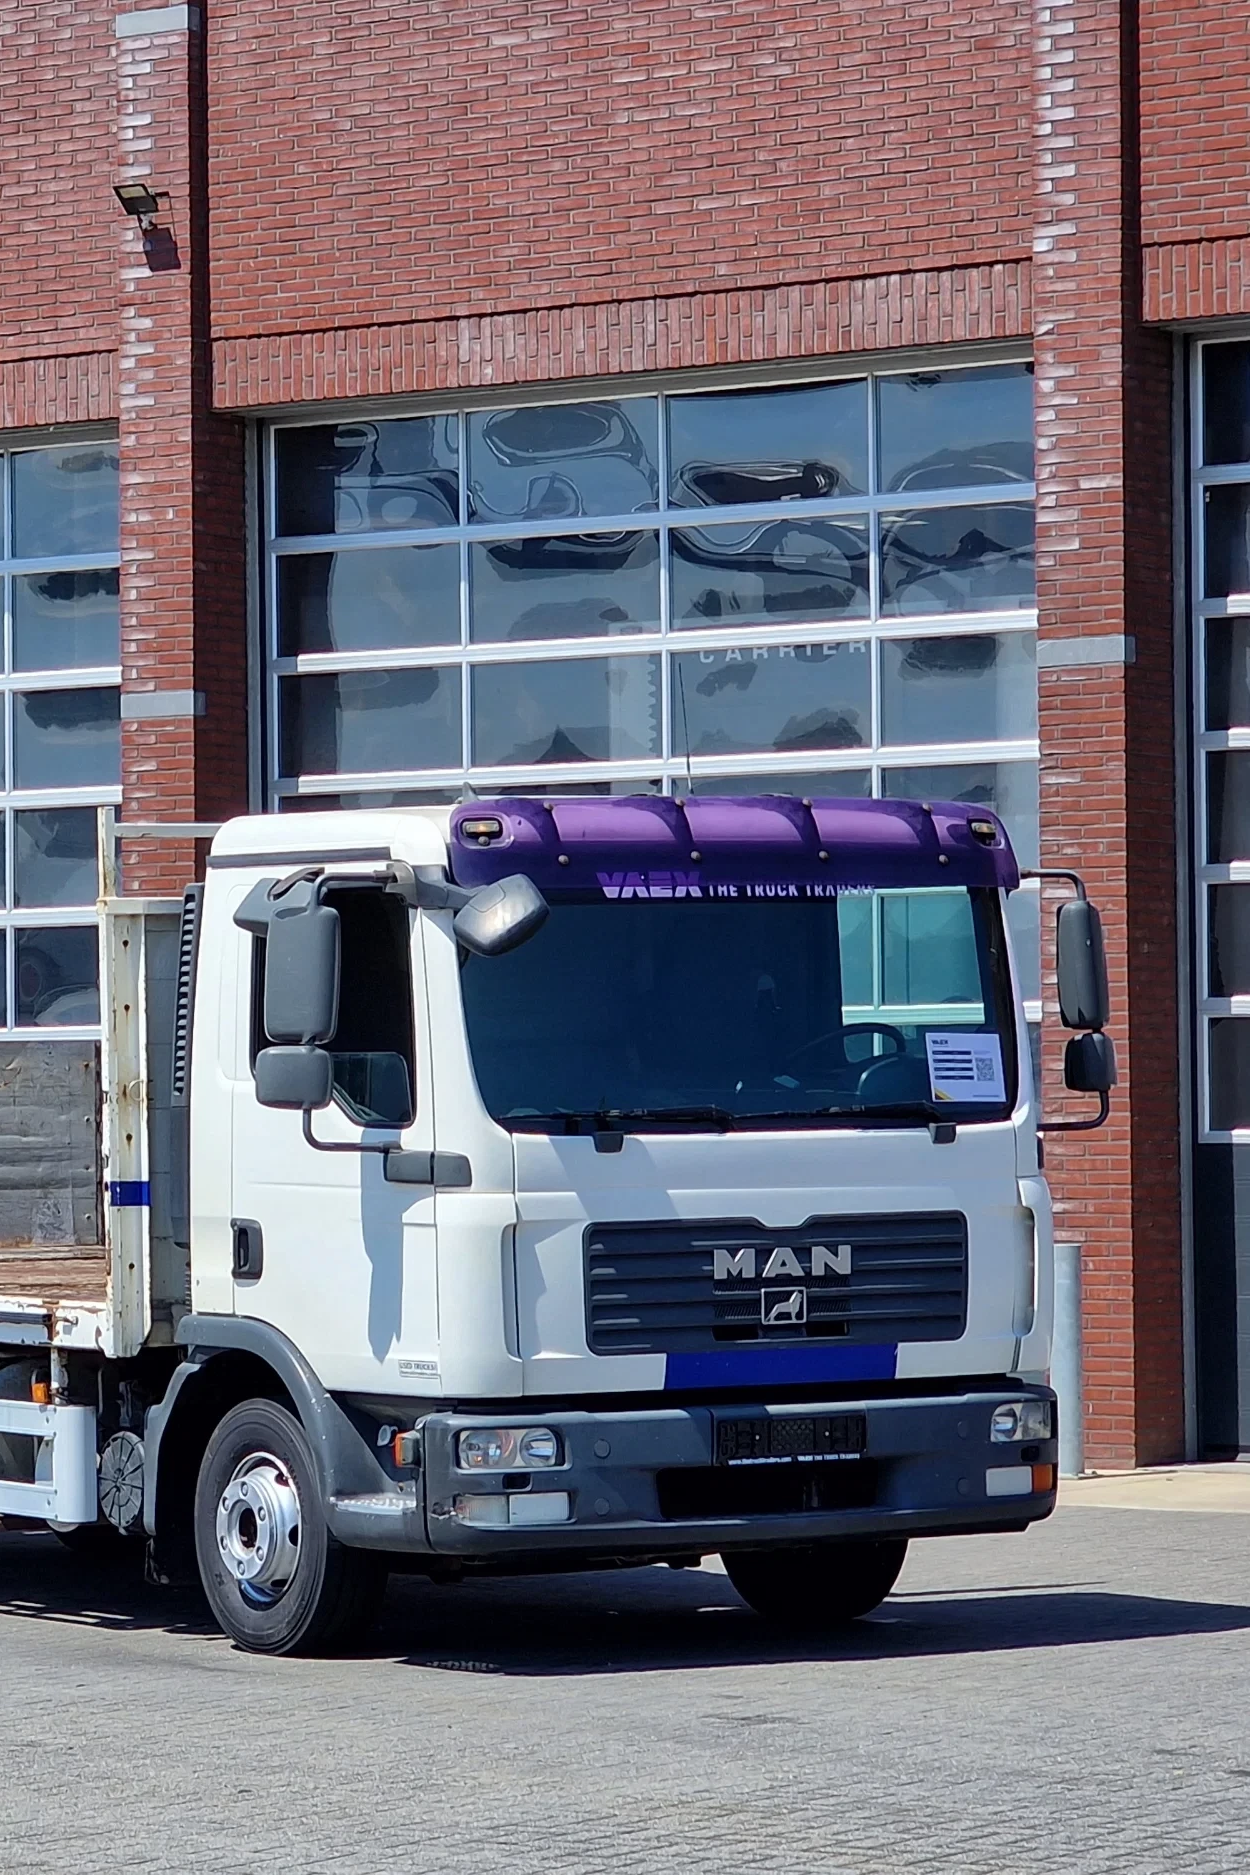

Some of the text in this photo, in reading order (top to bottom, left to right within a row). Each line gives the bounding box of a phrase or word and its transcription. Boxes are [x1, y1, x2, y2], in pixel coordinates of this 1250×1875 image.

[596, 871, 703, 898] VAEX
[709, 884, 738, 897] THE
[746, 884, 799, 897] TRUCK
[713, 1244, 852, 1280] MAN
